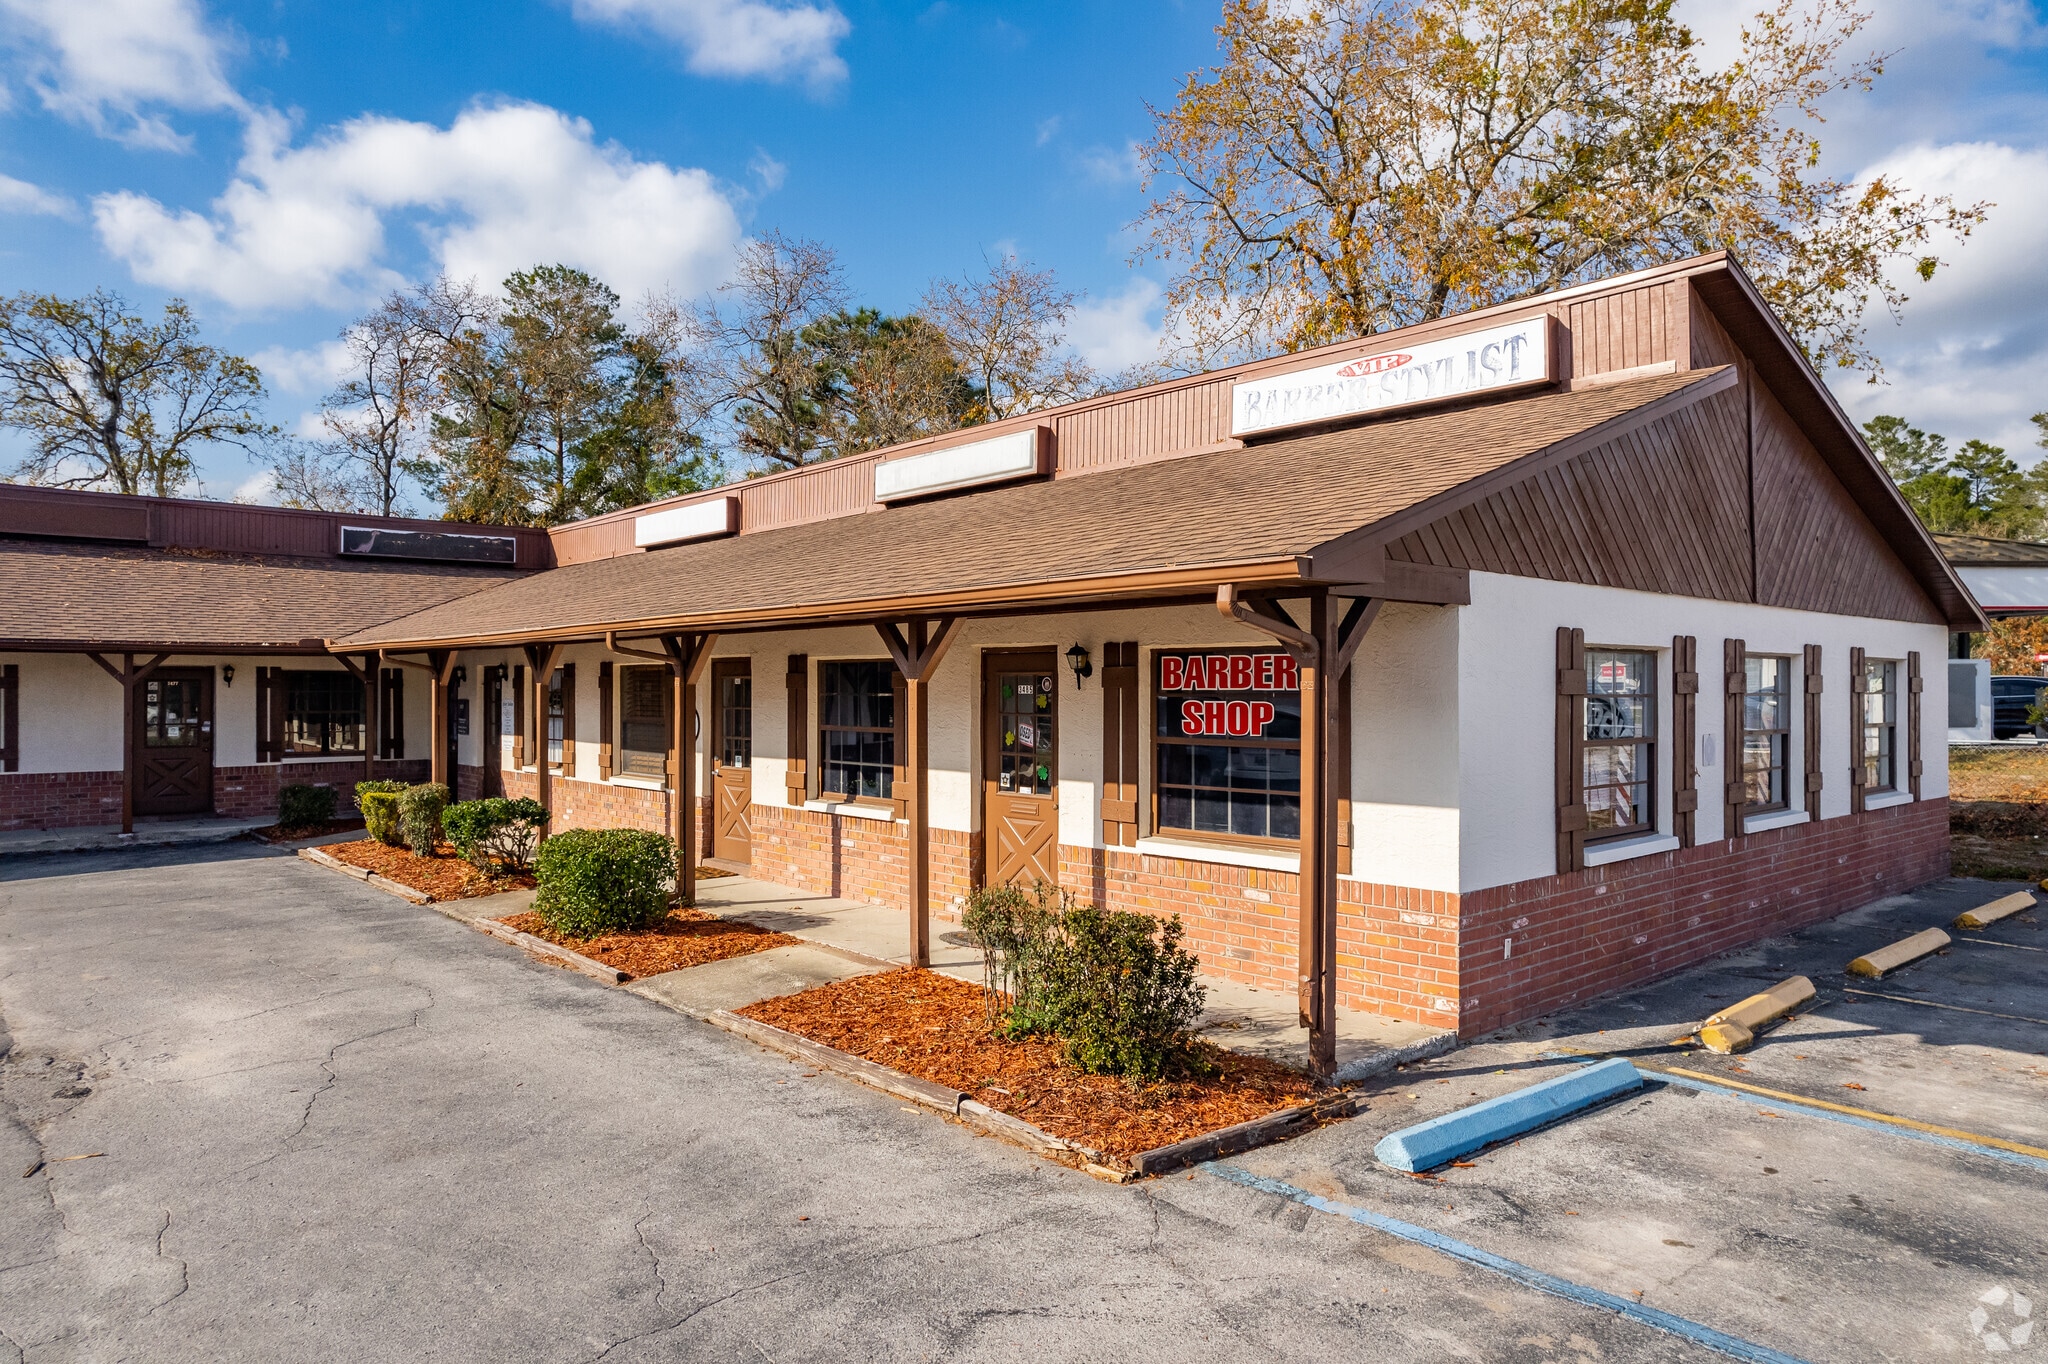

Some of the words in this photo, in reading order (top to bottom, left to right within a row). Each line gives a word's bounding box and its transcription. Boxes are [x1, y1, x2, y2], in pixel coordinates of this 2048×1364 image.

[1242, 377, 1369, 430] BARBER
[1379, 332, 1528, 403] STYLIST
[1351, 356, 1399, 375] VIP
[1161, 653, 1300, 691] BARBER
[1181, 700, 1275, 737] SHOP
